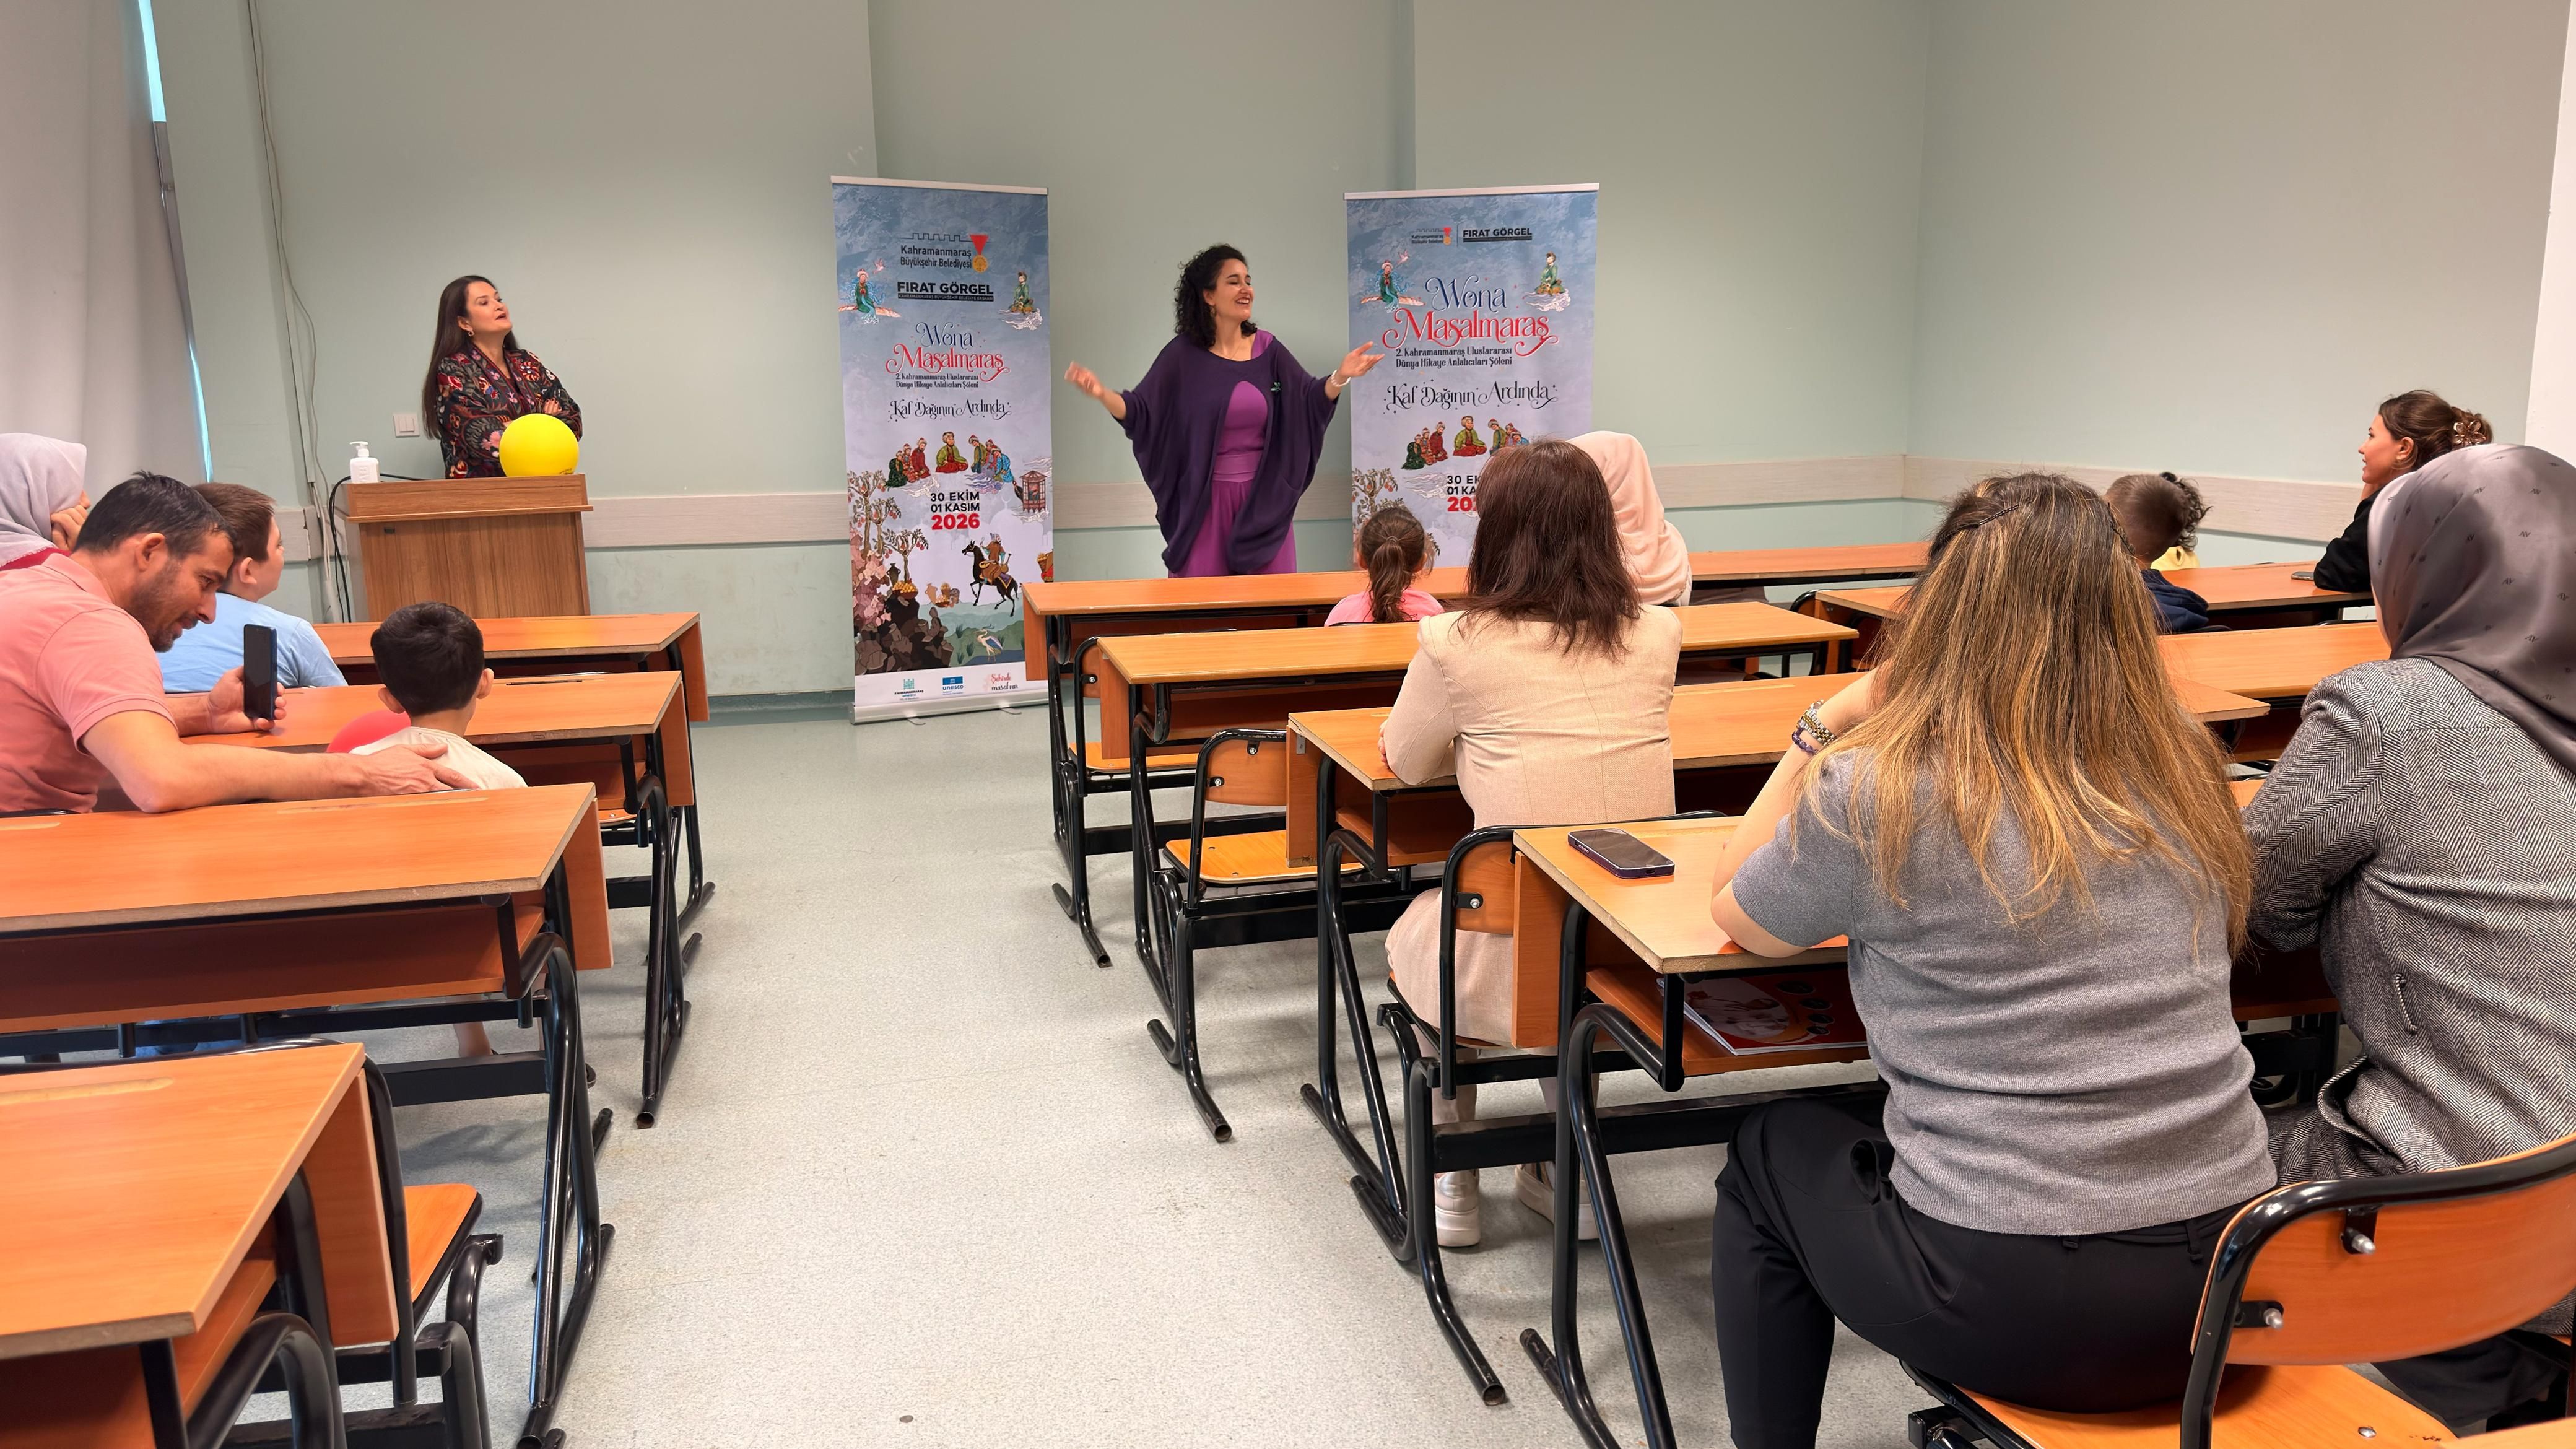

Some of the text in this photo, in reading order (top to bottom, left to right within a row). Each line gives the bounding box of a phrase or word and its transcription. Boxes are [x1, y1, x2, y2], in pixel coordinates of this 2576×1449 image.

[1463, 227, 1533, 237] FIRAT GÖRGEL
[901, 245, 972, 259] Kahramanmaraş
[900, 256, 938, 268] Büyükşehir
[939, 258, 972, 270] Belediyesi
[897, 281, 994, 295] FIRAT GÖRGEL
[1425, 274, 1507, 313] Wona
[915, 321, 973, 350] Wona
[1382, 308, 1560, 357] Masalmaraş
[1404, 347, 1466, 357] Kahramanmaraş
[1467, 346, 1512, 355] Uluslararası
[886, 344, 1011, 382] Masalmaraş
[1396, 357, 1512, 370] Dünya Hikaye Anlatıcıları Şöleni
[902, 373, 946, 381] Kahramanmaraş
[896, 381, 913, 389] Dünya
[962, 381, 979, 389] Şöleni
[1386, 380, 1559, 410] Kaf Dağının Ardında
[890, 399, 1012, 420] Kaf Dağının Ardında
[1447, 475, 1481, 484] 30 EK
[930, 489, 980, 502] 30 EKİM
[1447, 486, 1458, 495] 01
[931, 502, 980, 513] 01 KASIM
[1447, 496, 1477, 512] 20
[931, 513, 981, 531] 2026
[991, 681, 1009, 690] masal
